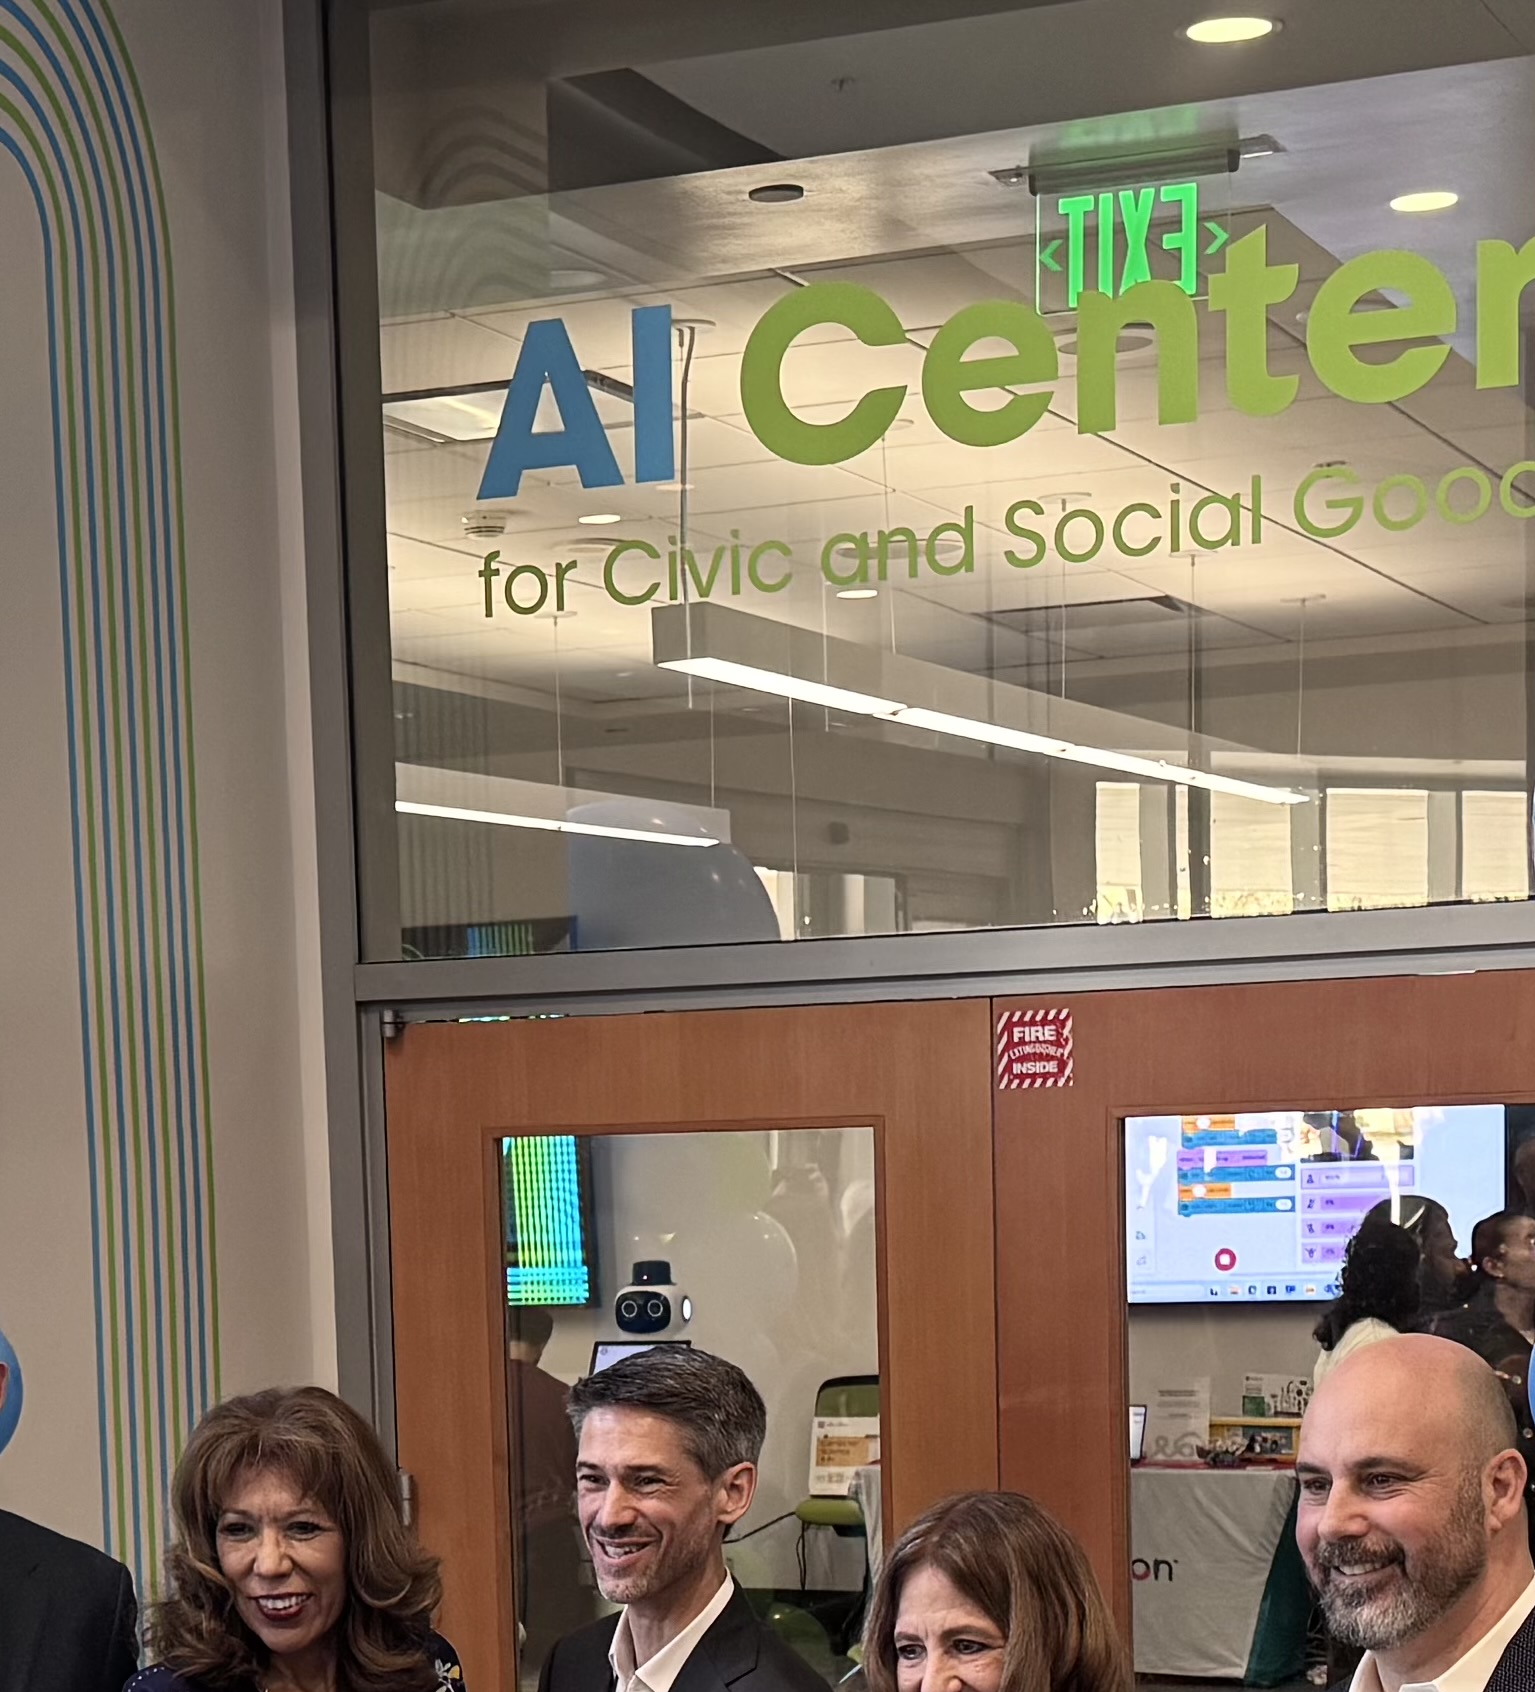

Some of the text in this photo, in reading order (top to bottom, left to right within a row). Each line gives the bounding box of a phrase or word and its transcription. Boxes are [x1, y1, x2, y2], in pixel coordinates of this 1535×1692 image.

[475, 304, 675, 501] AI
[478, 550, 578, 618] for
[603, 529, 793, 606] Civic
[821, 505, 975, 586] and
[1004, 474, 1262, 569] Social
[1012, 1025, 1057, 1042] FIRE
[1012, 1060, 1059, 1075] INSIDE
